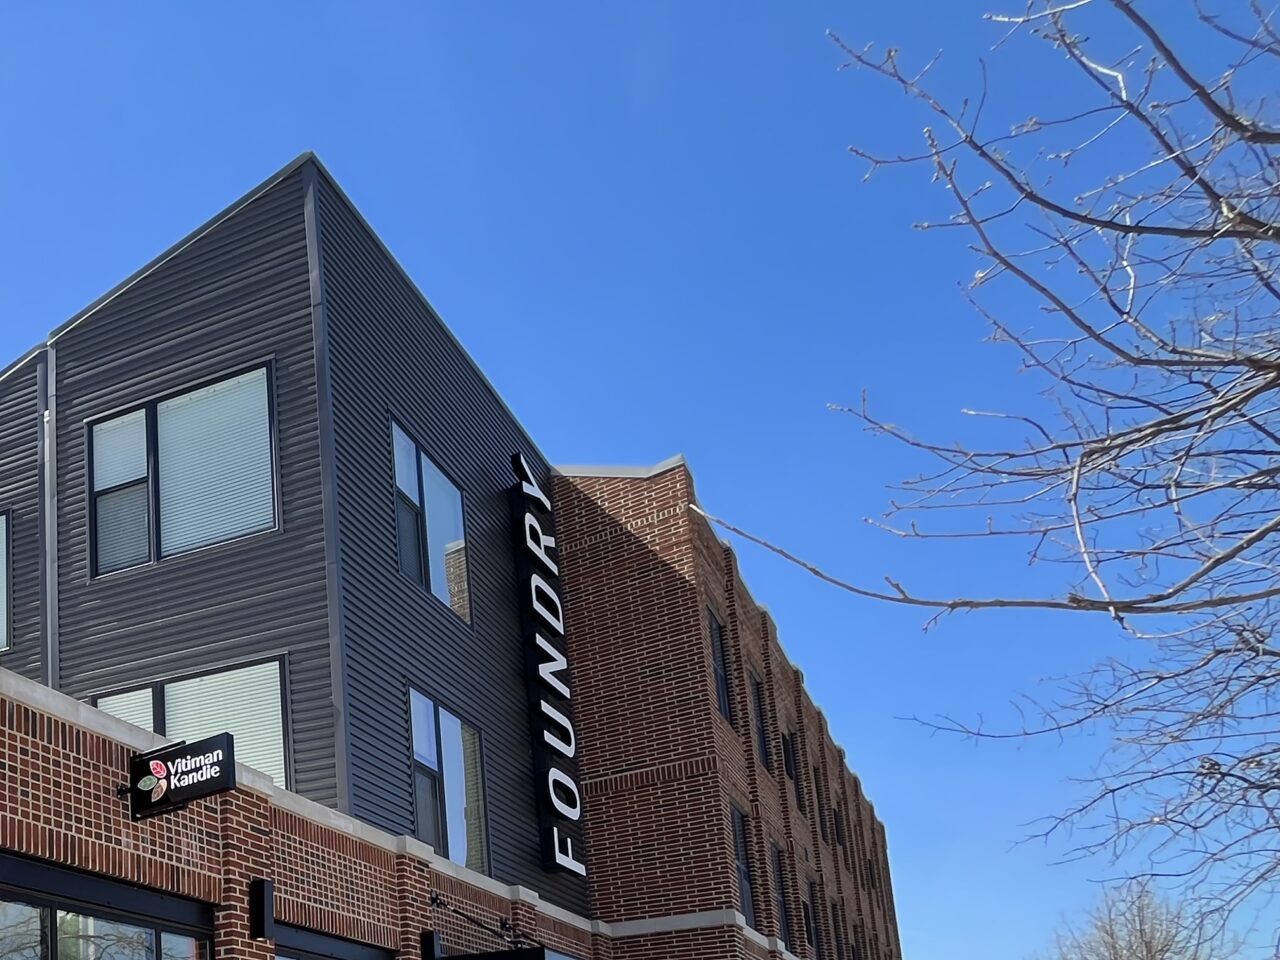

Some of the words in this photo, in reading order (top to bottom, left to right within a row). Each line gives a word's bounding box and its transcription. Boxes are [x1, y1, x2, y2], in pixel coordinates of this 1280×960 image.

[519, 453, 587, 878] FOUNDRY
[167, 749, 223, 775] Vitiman
[170, 765, 220, 790] Kandie
